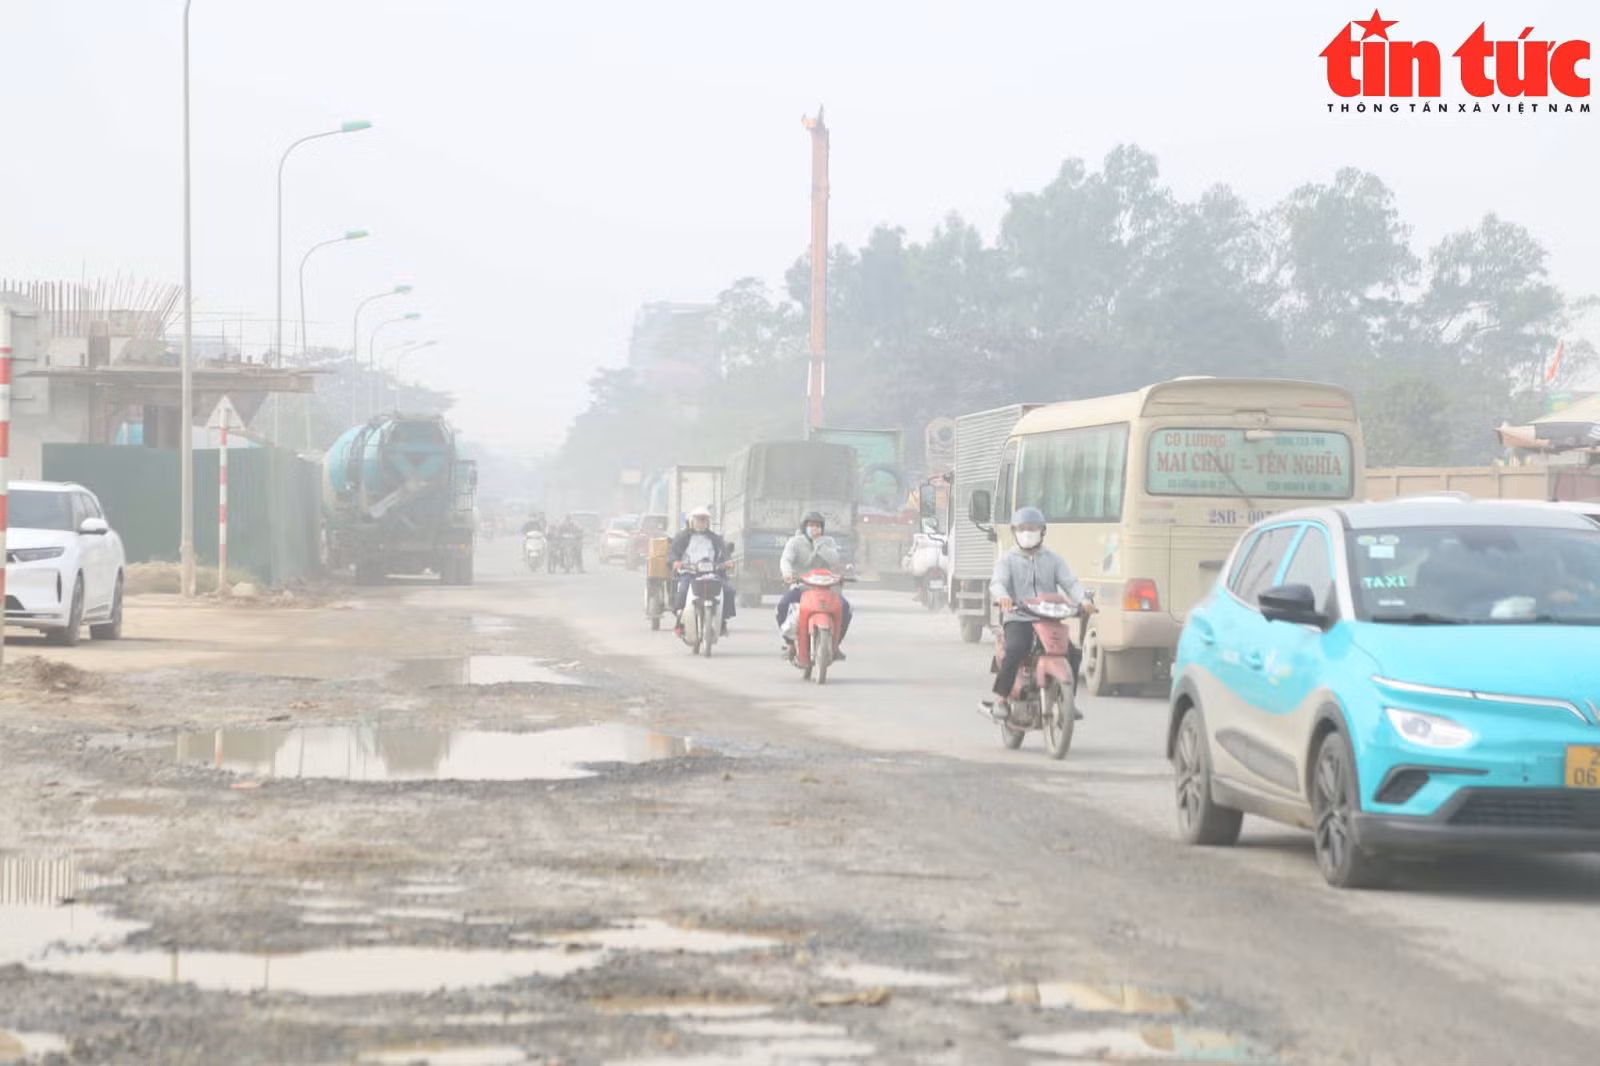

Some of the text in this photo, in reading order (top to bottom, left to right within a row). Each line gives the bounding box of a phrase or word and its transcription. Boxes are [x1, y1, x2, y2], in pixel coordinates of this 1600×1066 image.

[1157, 451, 1187, 473] MAI
[1292, 450, 1342, 476] NGHĨA
[1362, 576, 1406, 589] TAXI
